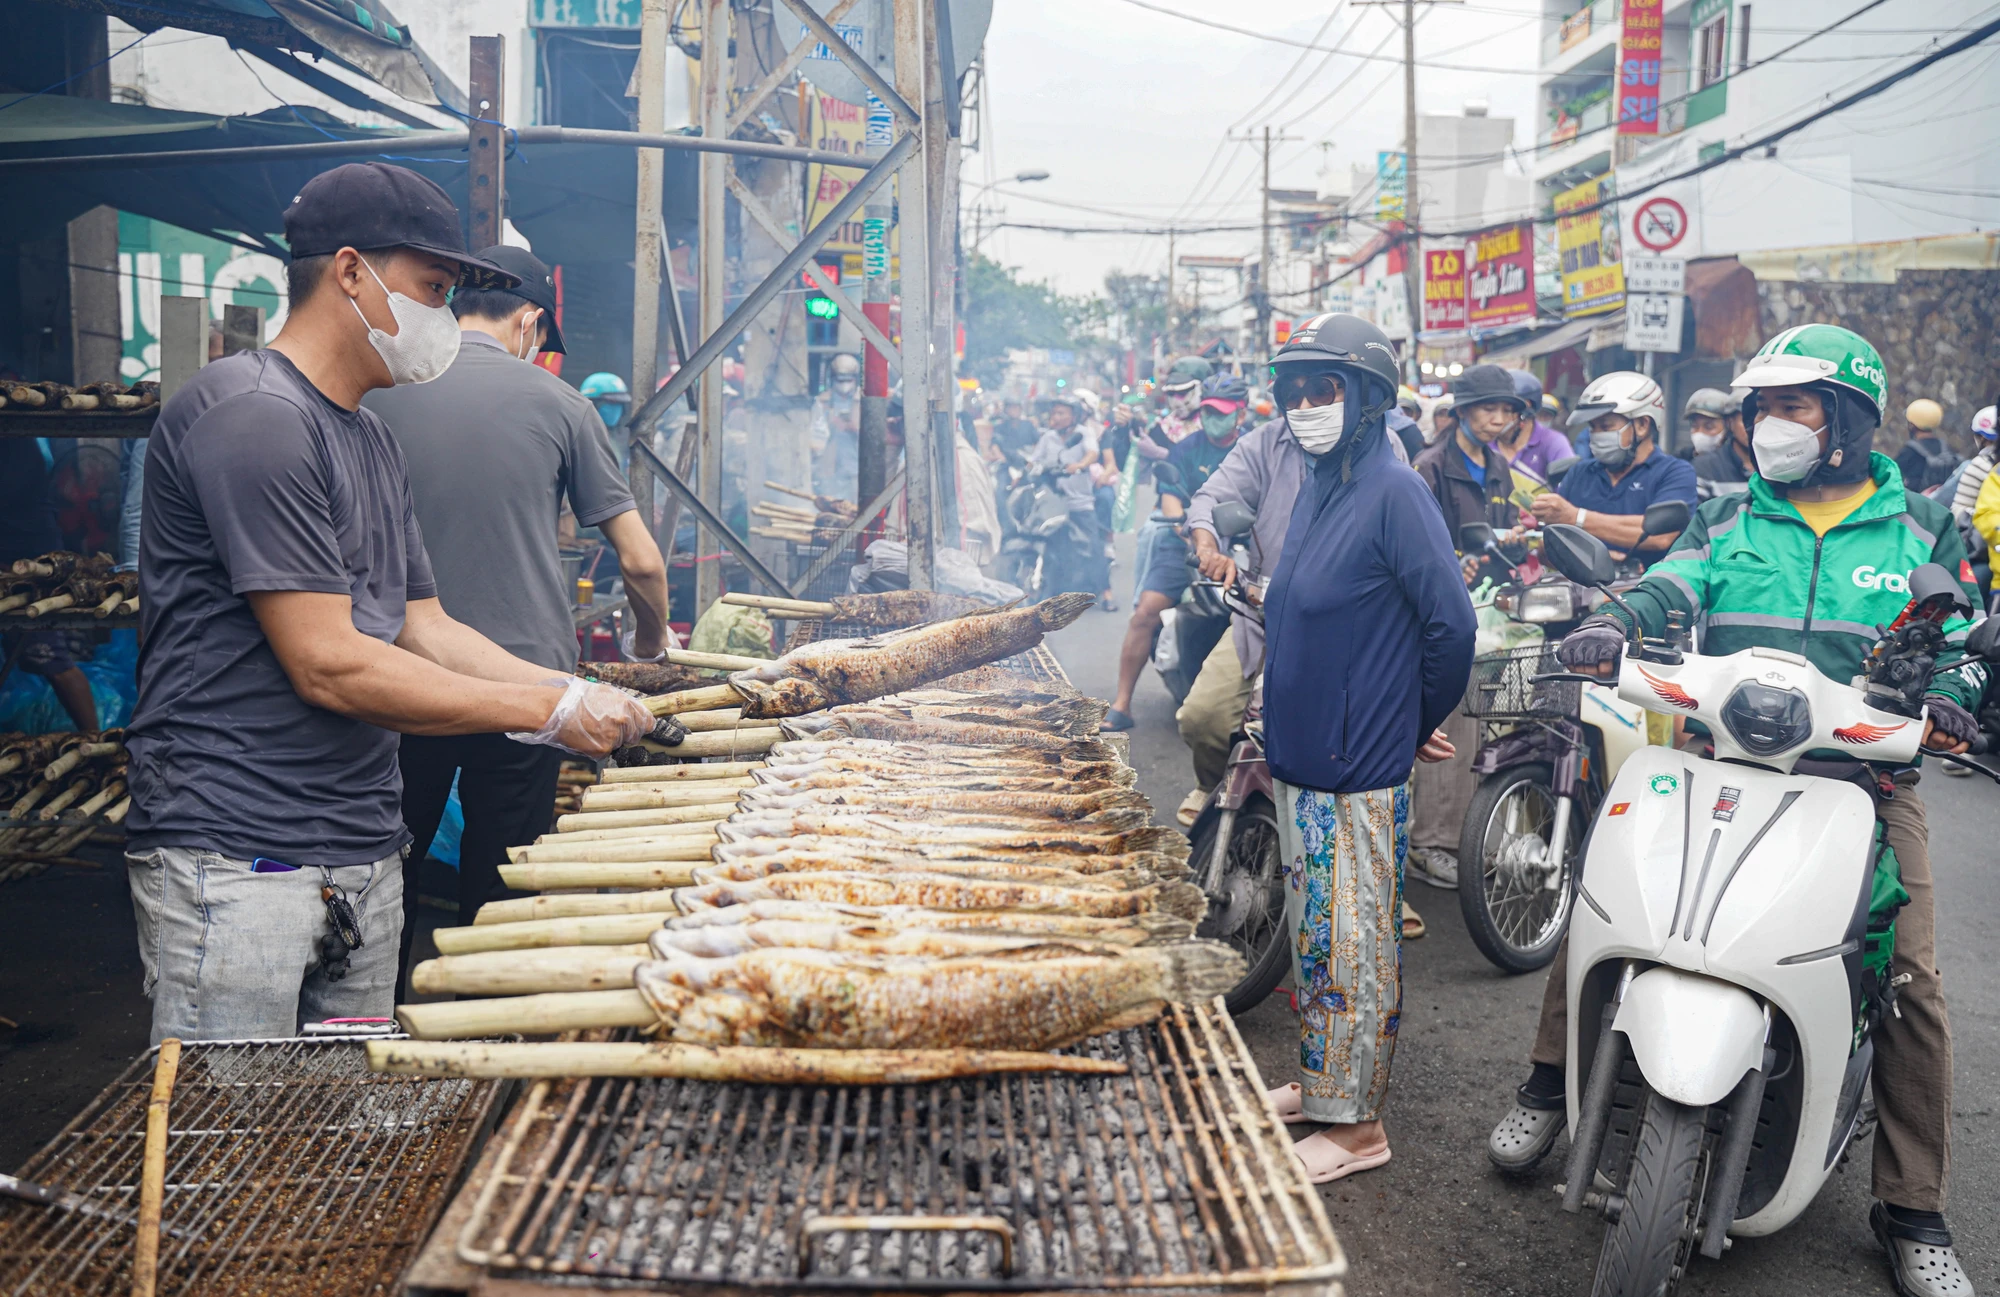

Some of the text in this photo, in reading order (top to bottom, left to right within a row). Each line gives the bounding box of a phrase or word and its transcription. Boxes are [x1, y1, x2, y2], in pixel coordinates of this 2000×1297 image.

[1622, 59, 1659, 87] SU
[1621, 96, 1658, 123] SU
[1431, 250, 1460, 276] LÒ
[1850, 357, 1886, 389] Grab
[1786, 449, 1804, 459] KN95
